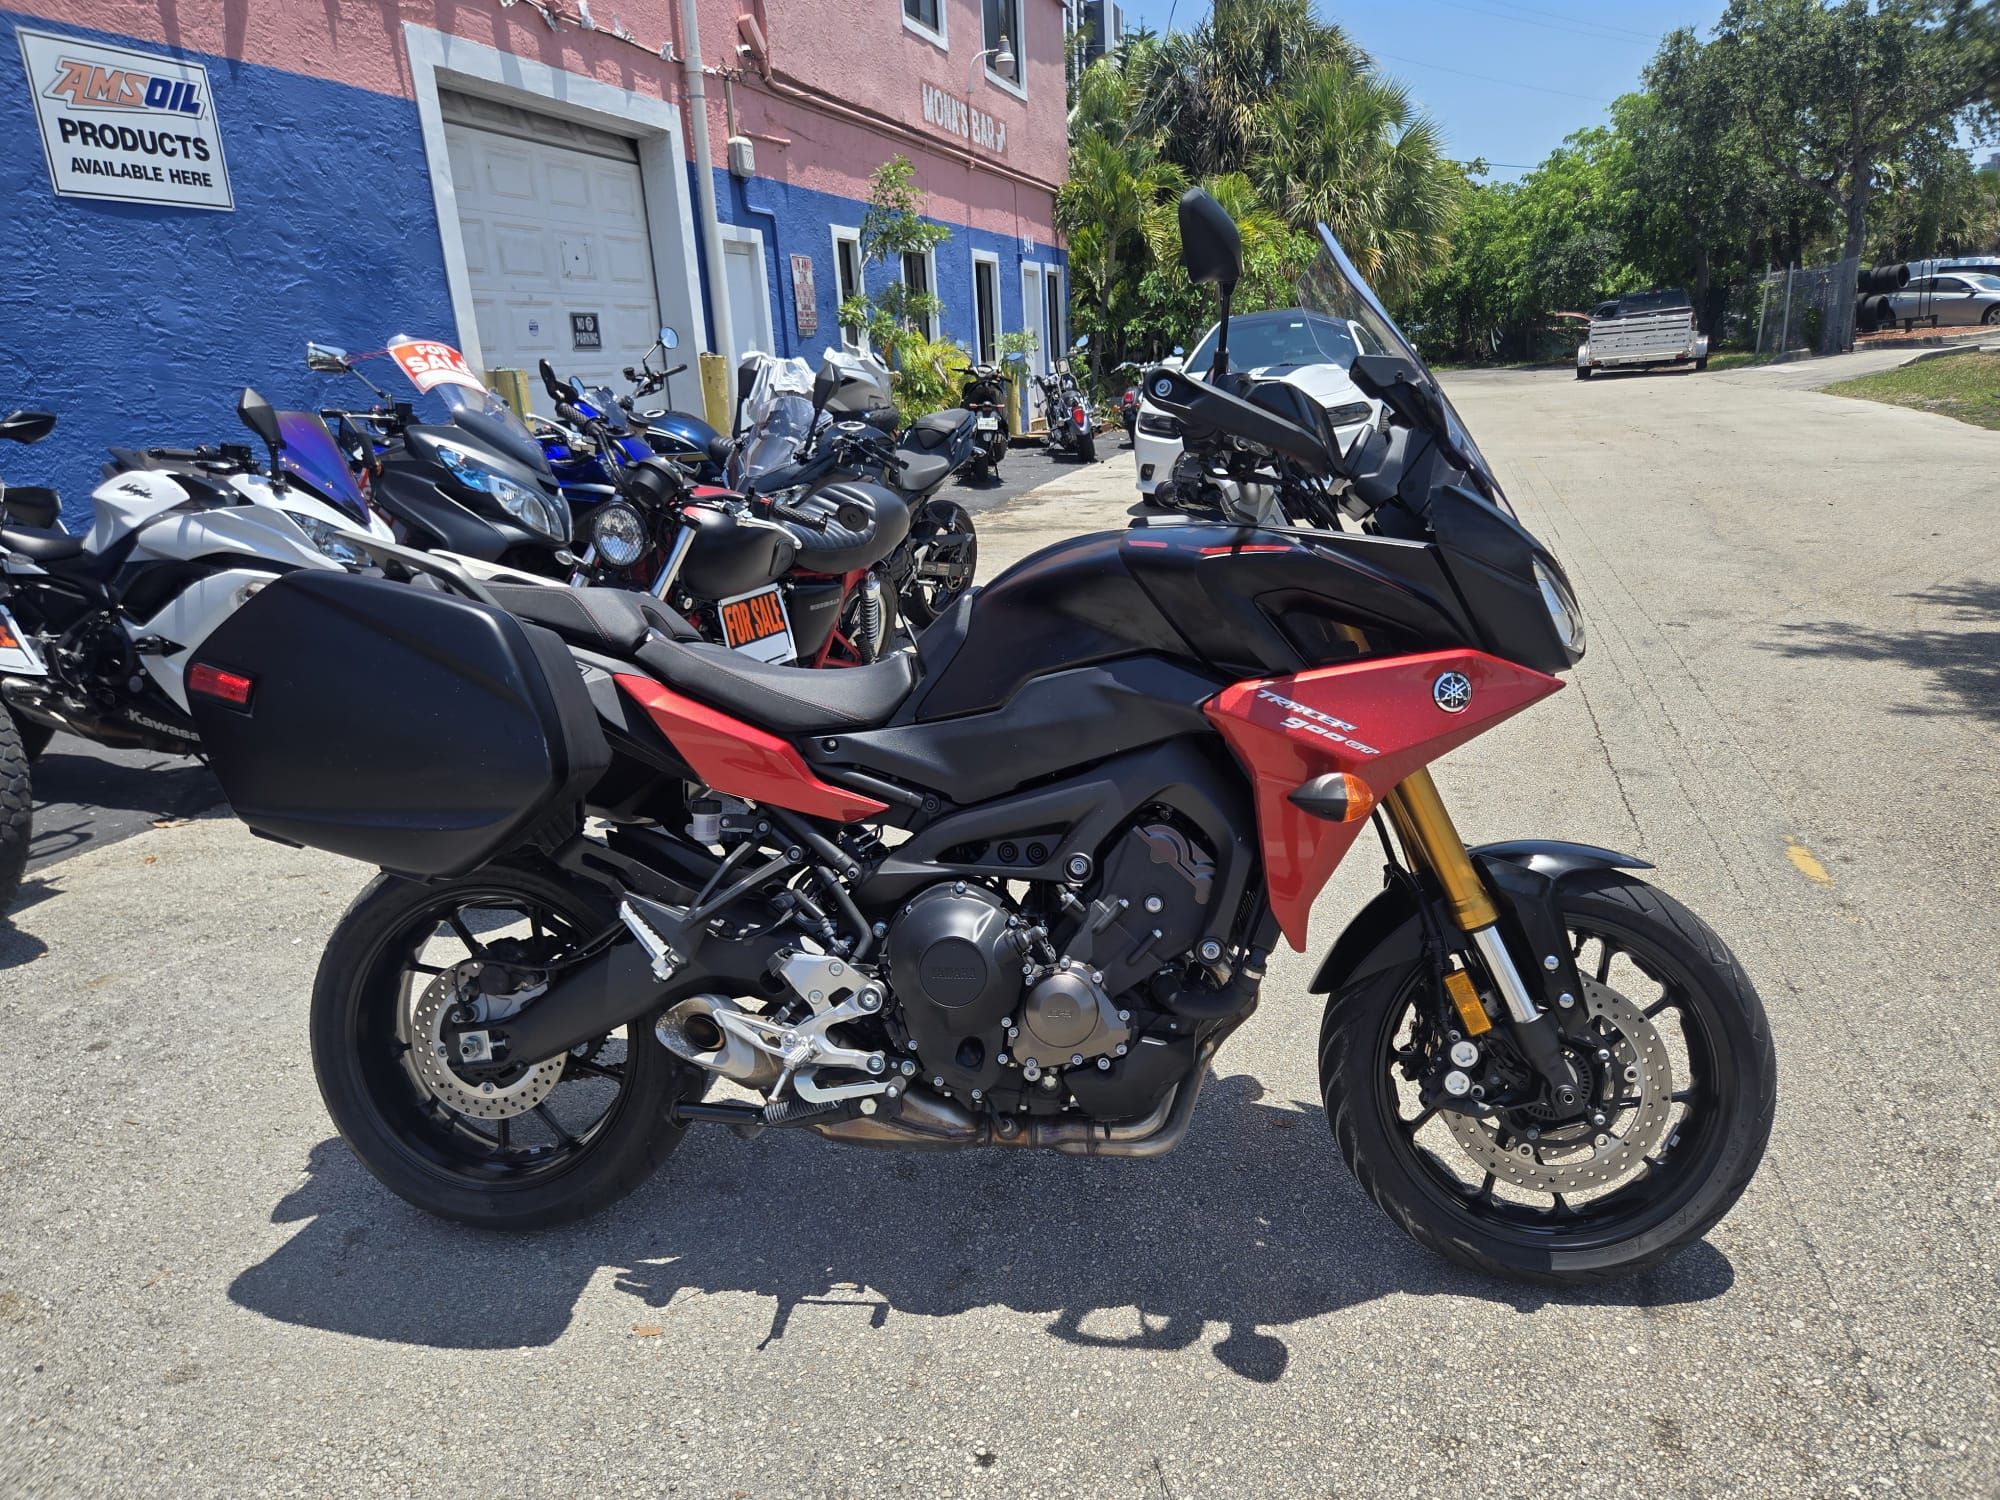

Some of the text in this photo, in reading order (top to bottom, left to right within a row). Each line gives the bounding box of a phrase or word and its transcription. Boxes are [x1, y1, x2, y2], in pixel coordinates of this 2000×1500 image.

[52, 60, 201, 114] AMSOIL
[922, 82, 995, 150] MONA'S BAR
[57, 117, 210, 162] PRODUCTS
[71, 156, 213, 188] AVAILABLE HERE
[575, 317, 585, 331] NO
[575, 332, 599, 345] PARKING
[405, 354, 476, 379] SALE
[414, 344, 451, 358] FOR
[723, 592, 786, 647] FOR SALE
[1257, 689, 1359, 733] TRACER
[1280, 716, 1381, 755] 900 GT
